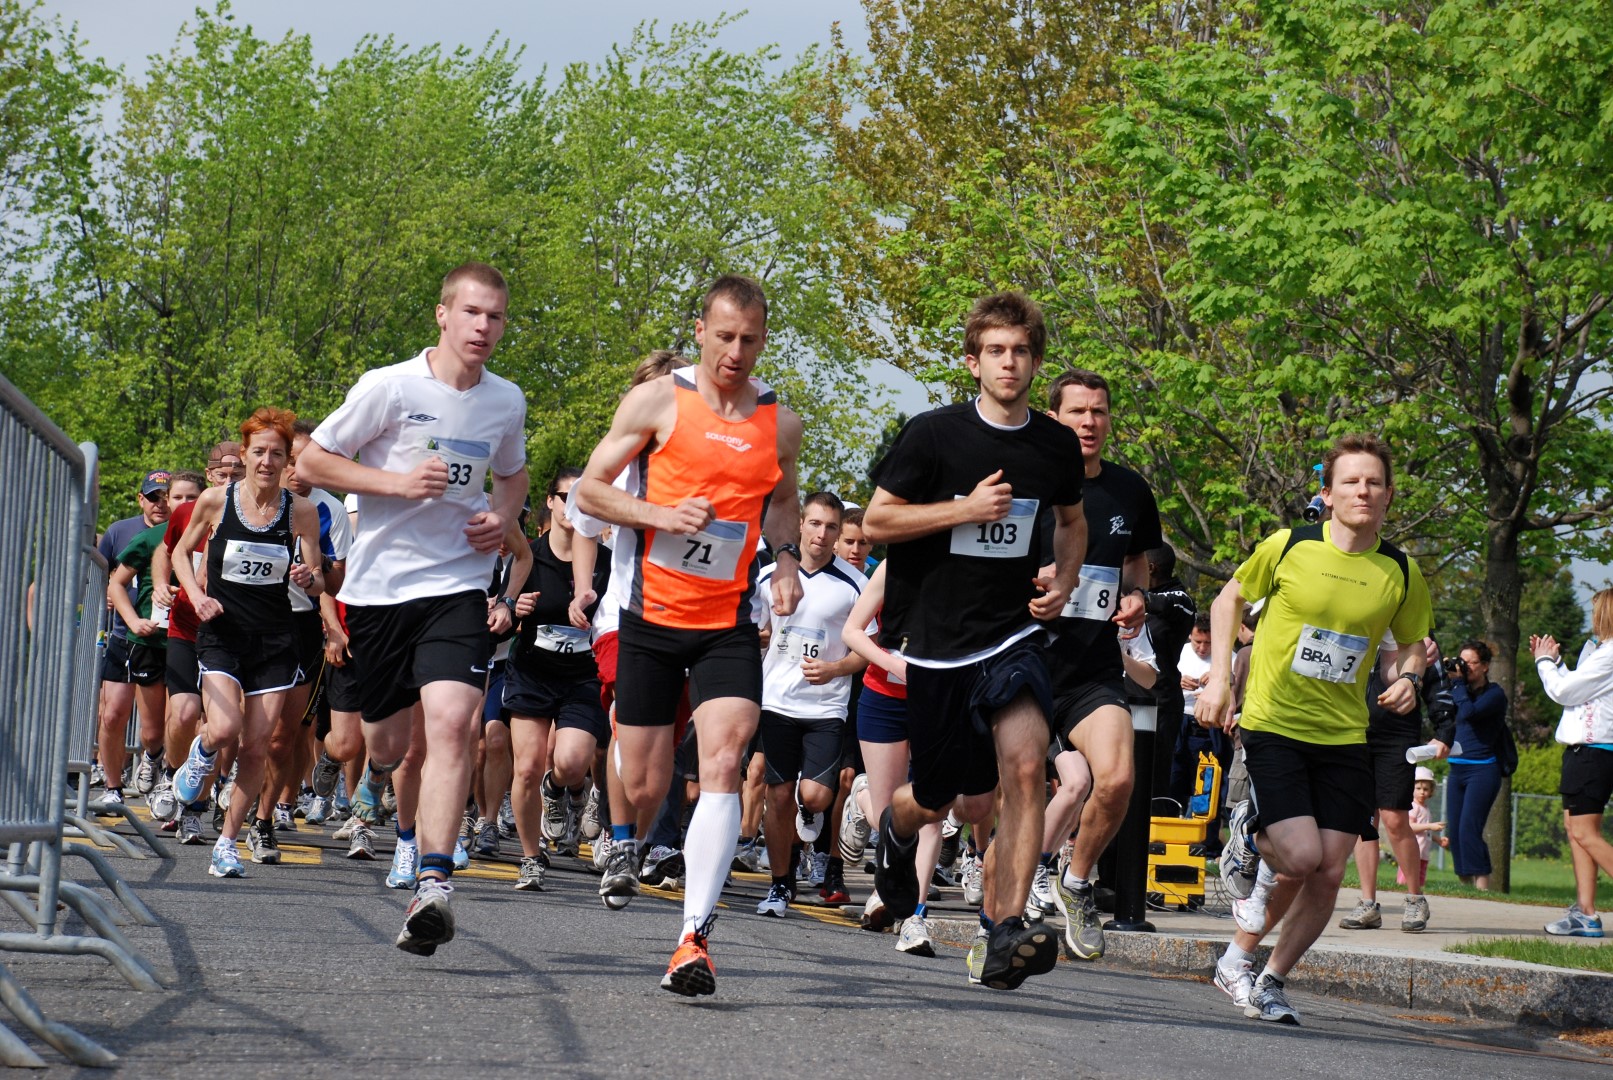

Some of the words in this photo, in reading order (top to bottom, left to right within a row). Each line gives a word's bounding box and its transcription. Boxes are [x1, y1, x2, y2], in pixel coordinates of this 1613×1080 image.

[705, 431, 744, 447] saucony
[443, 461, 472, 486] 33
[976, 522, 1018, 545] 103
[683, 539, 712, 565] 71
[240, 560, 273, 577] 378
[1097, 589, 1110, 609] 8
[555, 641, 574, 653] 76
[802, 643, 819, 658] 16
[1343, 656, 1356, 672] 3
